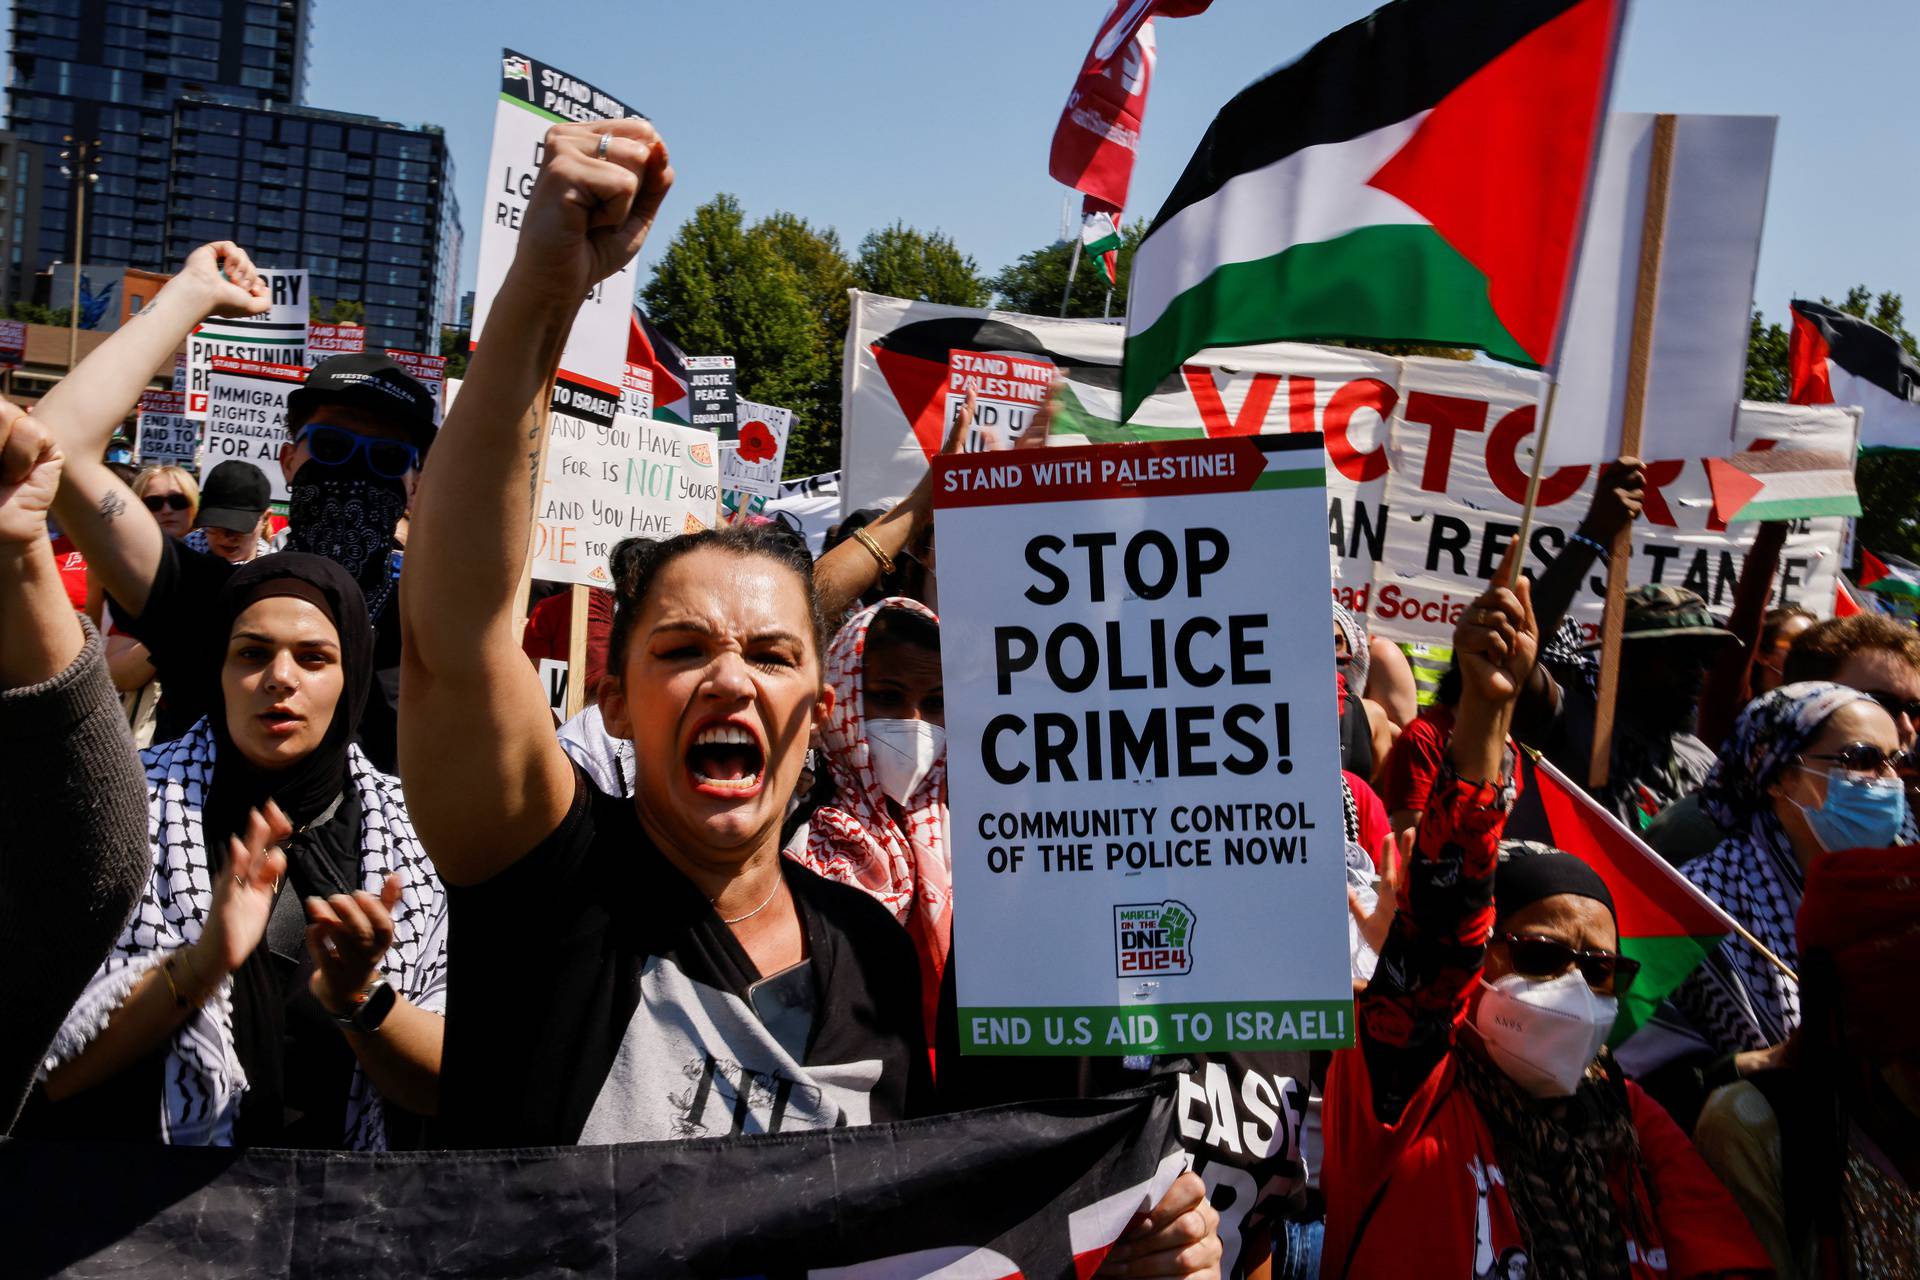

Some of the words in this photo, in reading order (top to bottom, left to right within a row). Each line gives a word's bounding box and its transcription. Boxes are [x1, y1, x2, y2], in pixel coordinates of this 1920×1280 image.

[541, 69, 590, 104] STAND
[309, 326, 336, 338] TAND
[338, 328, 364, 339] WITH
[309, 338, 364, 351] ALESTINE!
[214, 359, 240, 369] STAND
[241, 362, 261, 372] WITH
[421, 356, 445, 368] WITH
[951, 354, 1009, 376] STAND
[1011, 362, 1053, 384] WITH
[214, 385, 289, 409] IMMIGRA
[553, 385, 571, 404] TO
[572, 391, 616, 418] ISRAEL!
[143, 415, 169, 427] END
[212, 405, 267, 424] RIGHTS
[693, 413, 735, 424] EQUALITY!
[143, 428, 169, 441] AID
[175, 430, 195, 443] TO
[210, 421, 294, 442] LEGALIZATIO
[551, 416, 586, 440] AND
[639, 426, 681, 458] HAVE
[143, 441, 194, 455] ISRAEL!
[209, 436, 250, 458] FOR
[258, 442, 282, 461] AL
[562, 456, 591, 478] FOR
[603, 461, 620, 482] IS
[625, 458, 681, 501] NOT
[943, 468, 1023, 493] STAND
[1031, 461, 1092, 486] WITH
[1101, 453, 1236, 482] PALESTINE!
[630, 506, 673, 533] HAVE
[586, 541, 611, 559] FOR
[1023, 527, 1230, 606] STOP
[994, 613, 1272, 696] POLICE
[981, 702, 1294, 786] CRIMES!
[978, 807, 1158, 840] COMMUNITY
[1170, 802, 1316, 832] CONTROL
[987, 845, 1025, 874] OF
[1037, 843, 1094, 872] THE
[1106, 839, 1212, 871] POLICE
[1224, 836, 1308, 866] NOW!
[1120, 910, 1159, 921] MARCH
[1121, 921, 1134, 930] ON
[1139, 920, 1157, 929] THE
[1121, 929, 1170, 950] DNC
[1121, 949, 1187, 972] 2024
[972, 1016, 1032, 1045] END
[1044, 1016, 1093, 1045] U.S
[1105, 1014, 1159, 1044] AID
[1171, 1013, 1213, 1042] TO
[1226, 1010, 1346, 1040] ISRAEL!
